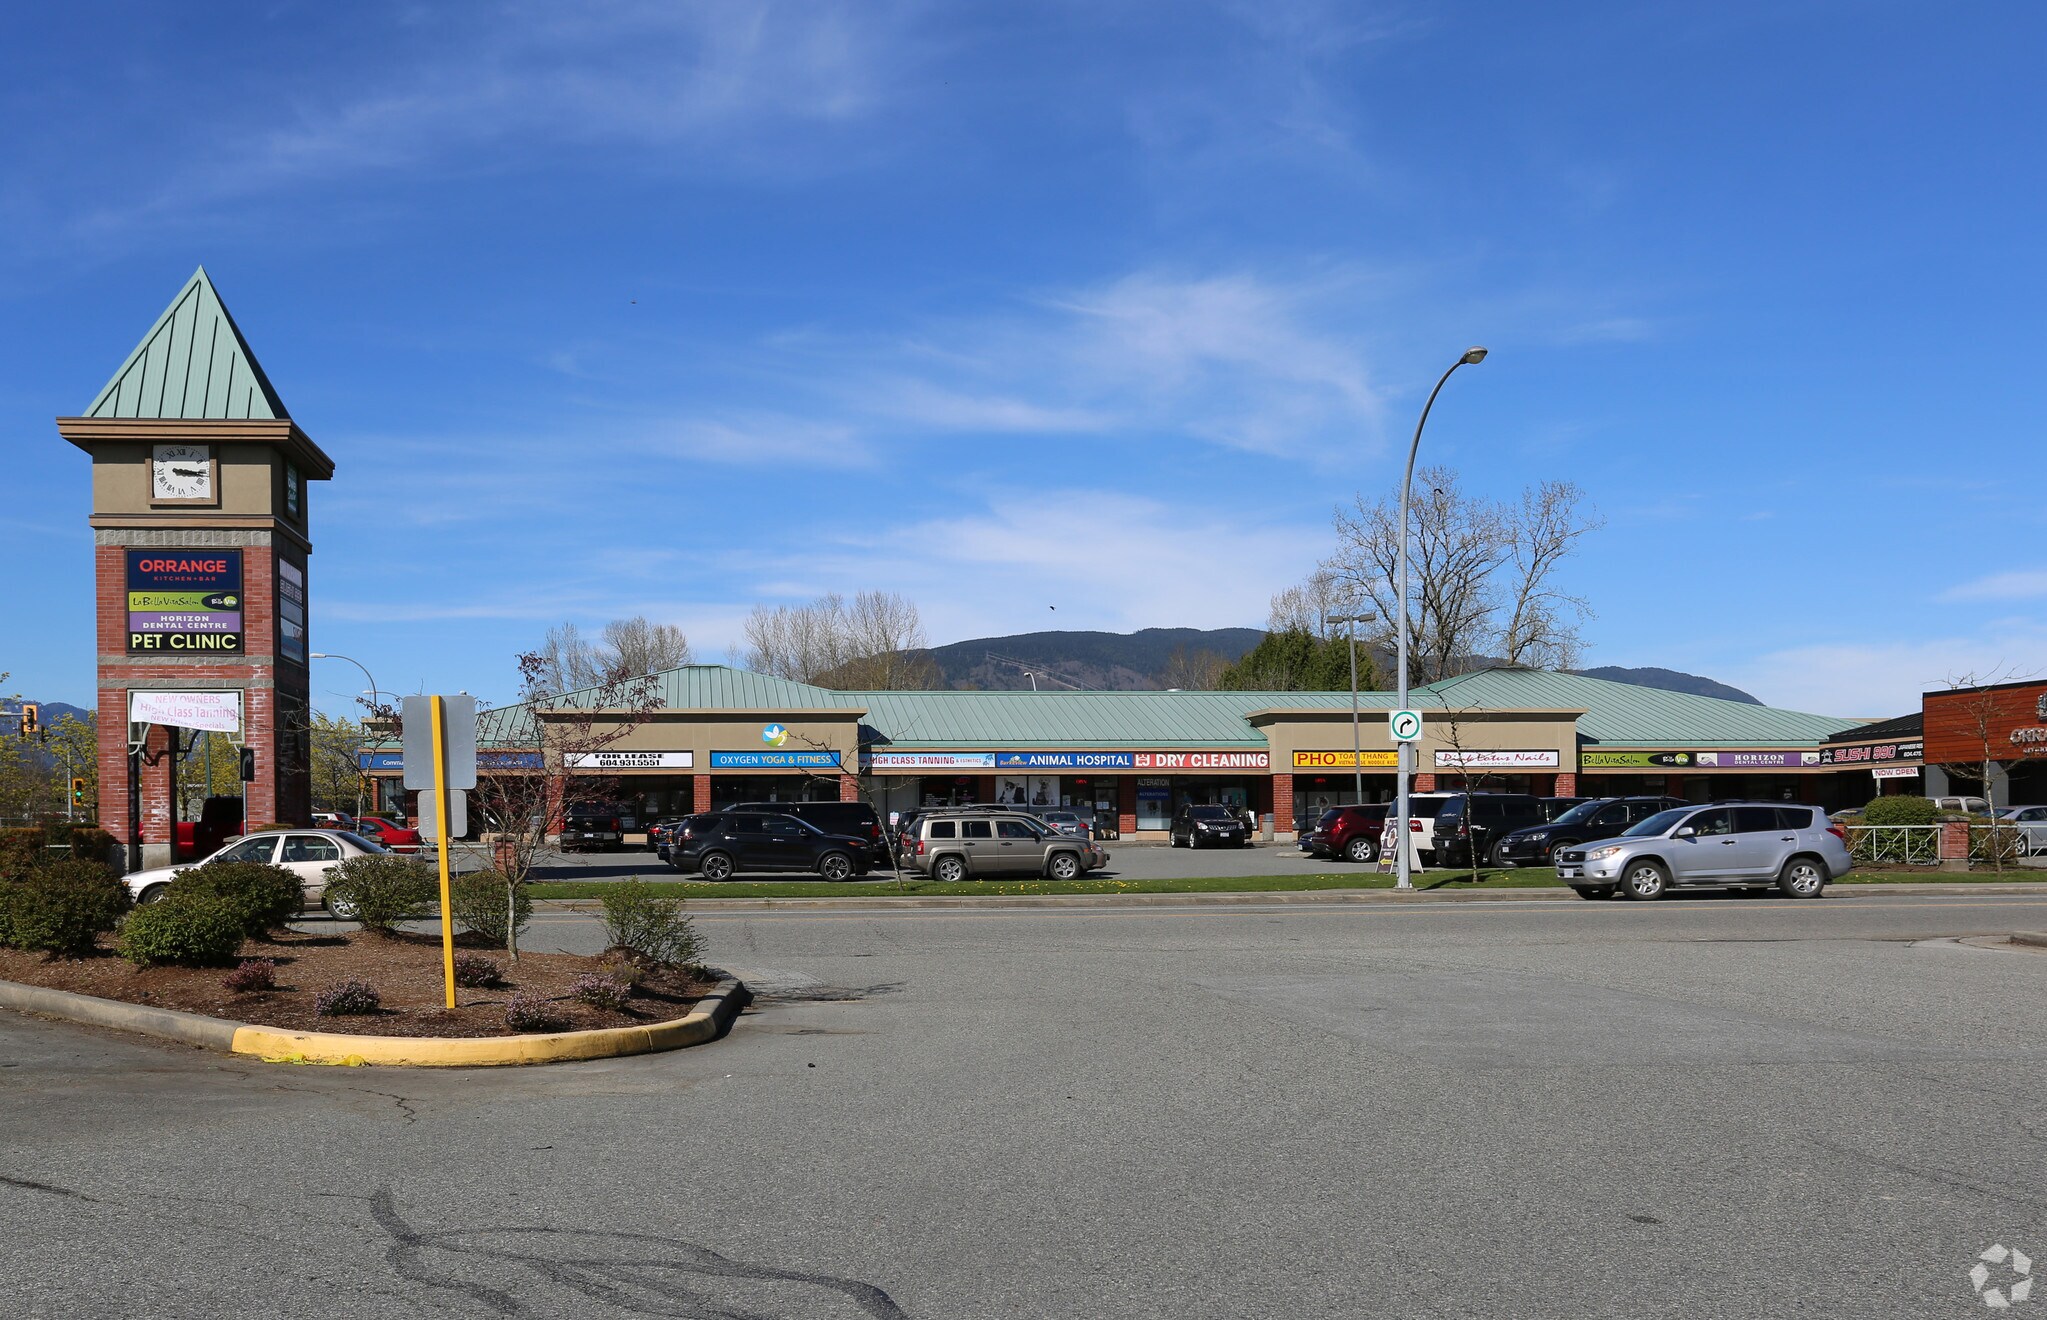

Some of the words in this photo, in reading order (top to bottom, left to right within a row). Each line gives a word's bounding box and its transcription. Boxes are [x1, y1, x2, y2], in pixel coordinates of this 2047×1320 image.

[139, 559, 227, 573] ORRANGE
[132, 634, 163, 649] PET
[169, 634, 237, 649] CLINIC
[155, 695, 178, 704] NEW
[179, 695, 221, 704] OWNERS
[167, 706, 193, 718] Class
[194, 706, 237, 721] Tanning
[720, 756, 758, 764] OXYGEN
[761, 756, 786, 764] YOGA
[788, 756, 795, 764] &
[797, 755, 831, 764] FITNESS
[891, 756, 916, 764] CLASS
[918, 756, 955, 764] TANNING
[1297, 753, 1336, 765] PHO
[1514, 753, 1551, 762] Nails
[1834, 747, 1872, 762] SUSHI
[599, 759, 660, 767] 604.931.5551
[1029, 755, 1072, 765] ANIMAL
[1076, 755, 1130, 766] HOSPITAL
[1155, 754, 1186, 767] DRY
[1190, 754, 1268, 767] CLEANING
